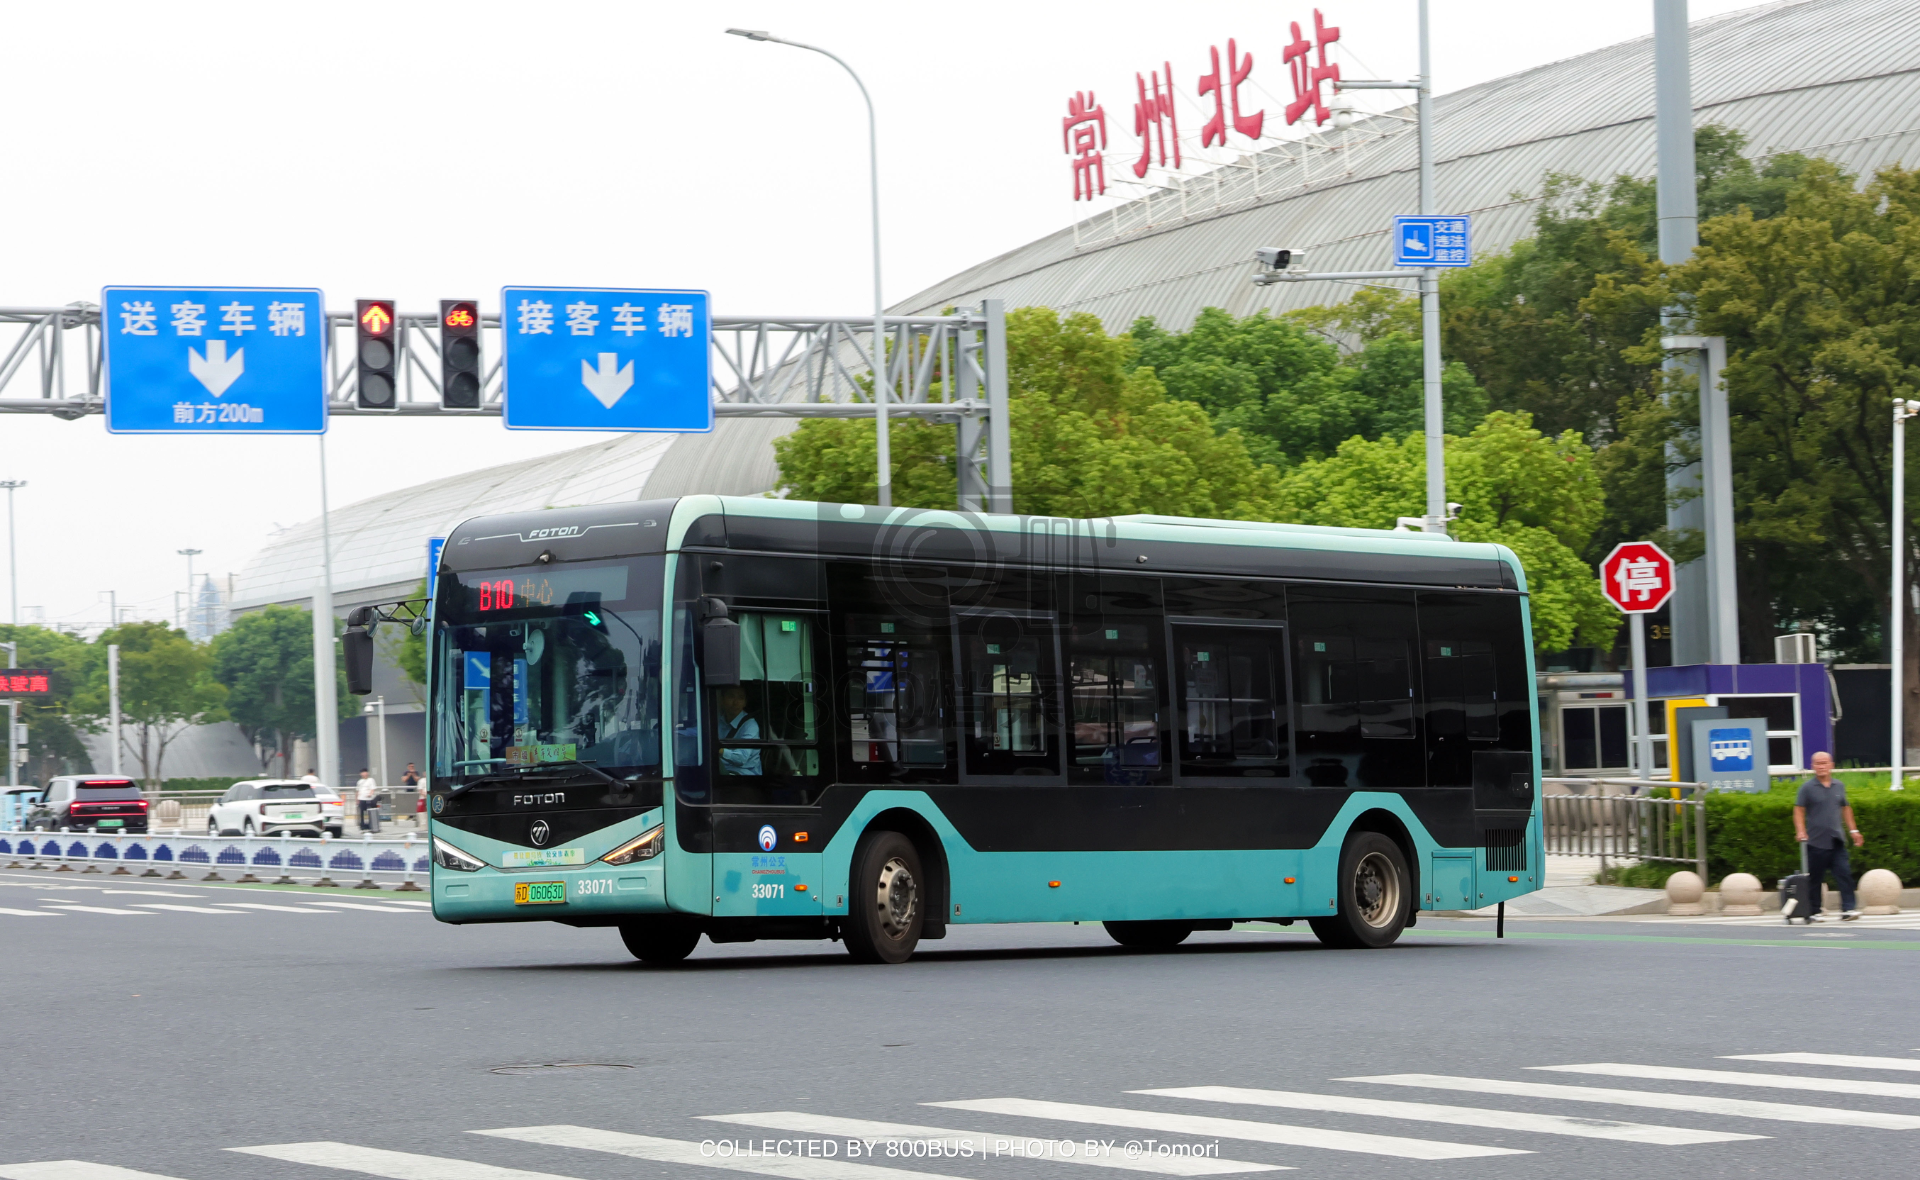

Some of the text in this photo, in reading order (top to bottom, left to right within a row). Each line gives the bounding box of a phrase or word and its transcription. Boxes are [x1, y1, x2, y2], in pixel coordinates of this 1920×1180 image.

[1062, 8, 1340, 201] 常州北站
[1434, 221, 1465, 233] 交通
[1434, 235, 1465, 247] 违法
[1434, 249, 1465, 261] 监控
[120, 300, 306, 337] 送客车辆
[517, 299, 694, 338] 接客车辆
[172, 402, 264, 424] 前方200m
[528, 526, 579, 539] FOTON
[1614, 556, 1663, 602] 停
[479, 579, 514, 611] B10
[513, 791, 566, 806] FOTON
[751, 856, 786, 867] 常州公交
[578, 879, 613, 894] 33071
[752, 883, 784, 899] 33071
